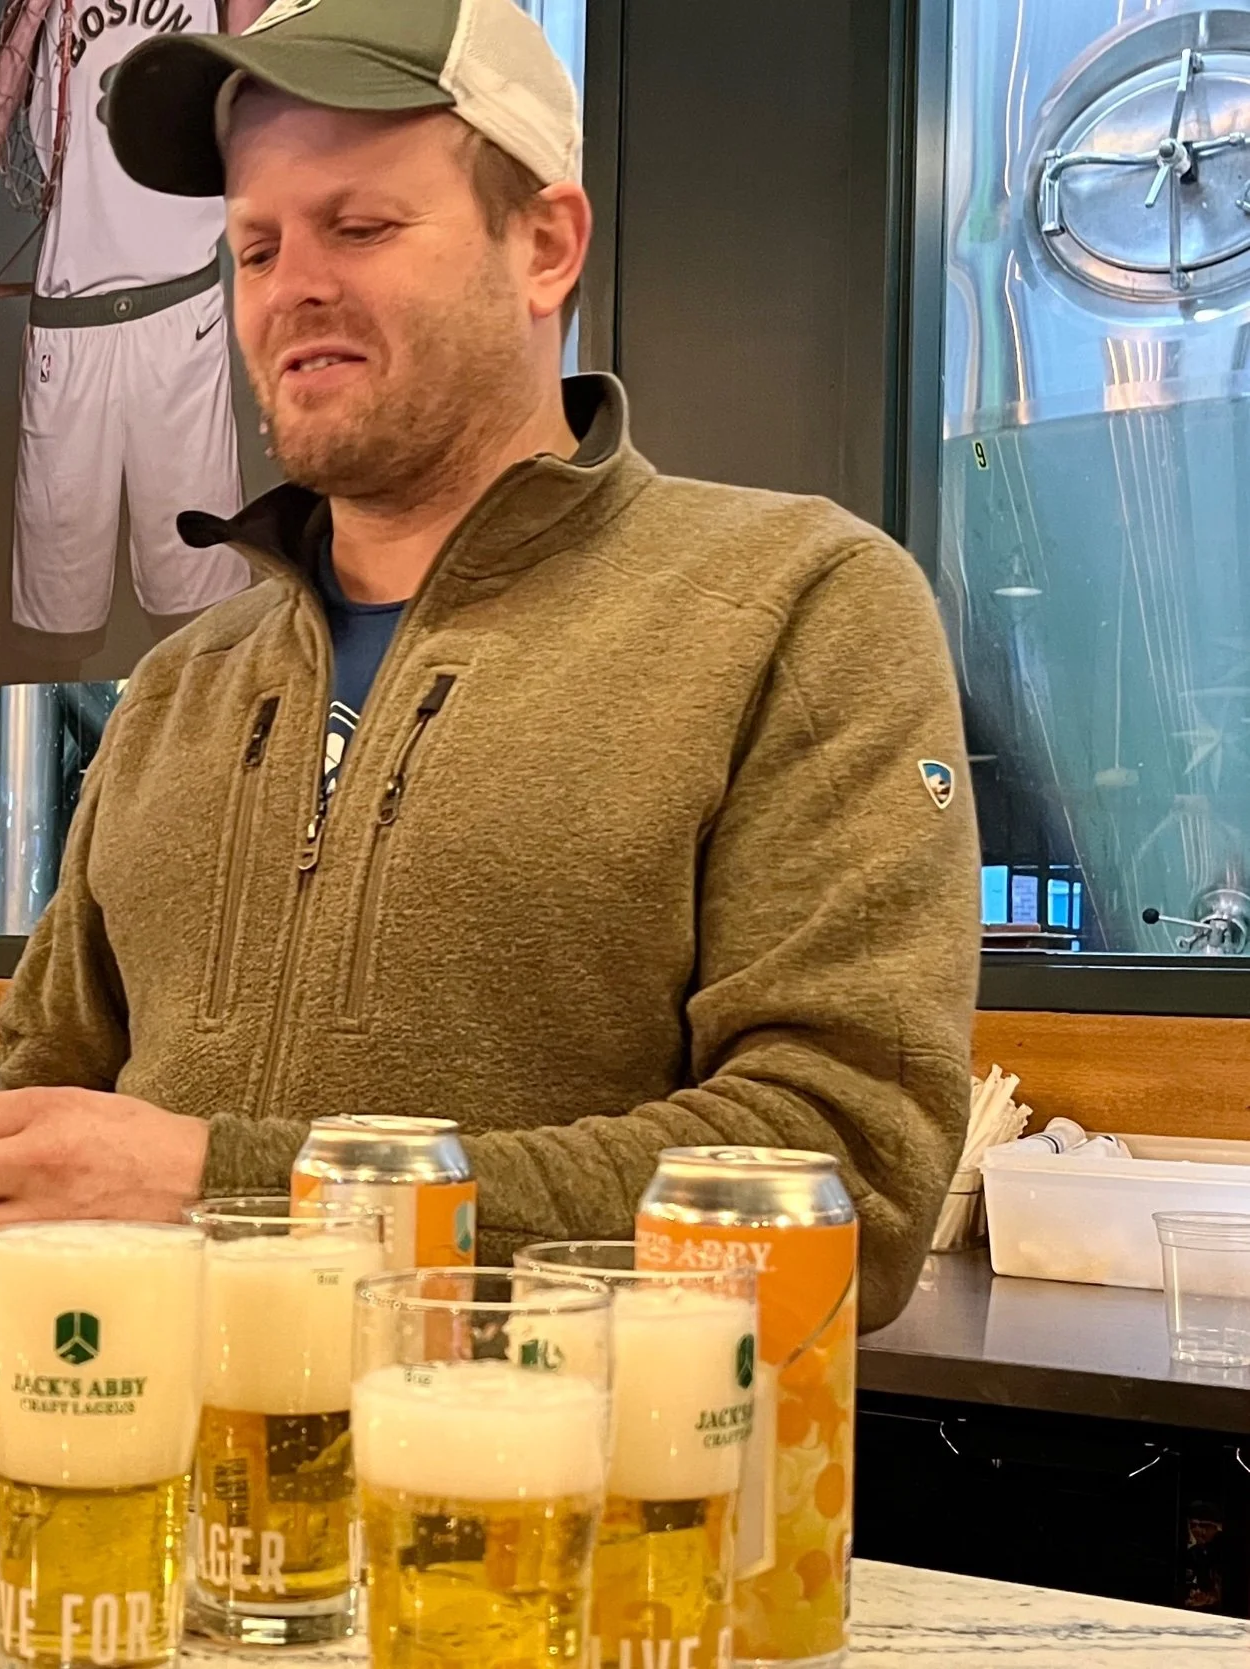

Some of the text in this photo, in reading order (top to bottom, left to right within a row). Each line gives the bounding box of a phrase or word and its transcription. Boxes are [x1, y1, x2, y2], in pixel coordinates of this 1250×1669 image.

[975, 442, 987, 468] 9
[13, 1374, 147, 1398] JACK'S ABBY
[21, 1399, 67, 1414] CRAFT
[61, 1592, 151, 1666] FOR
